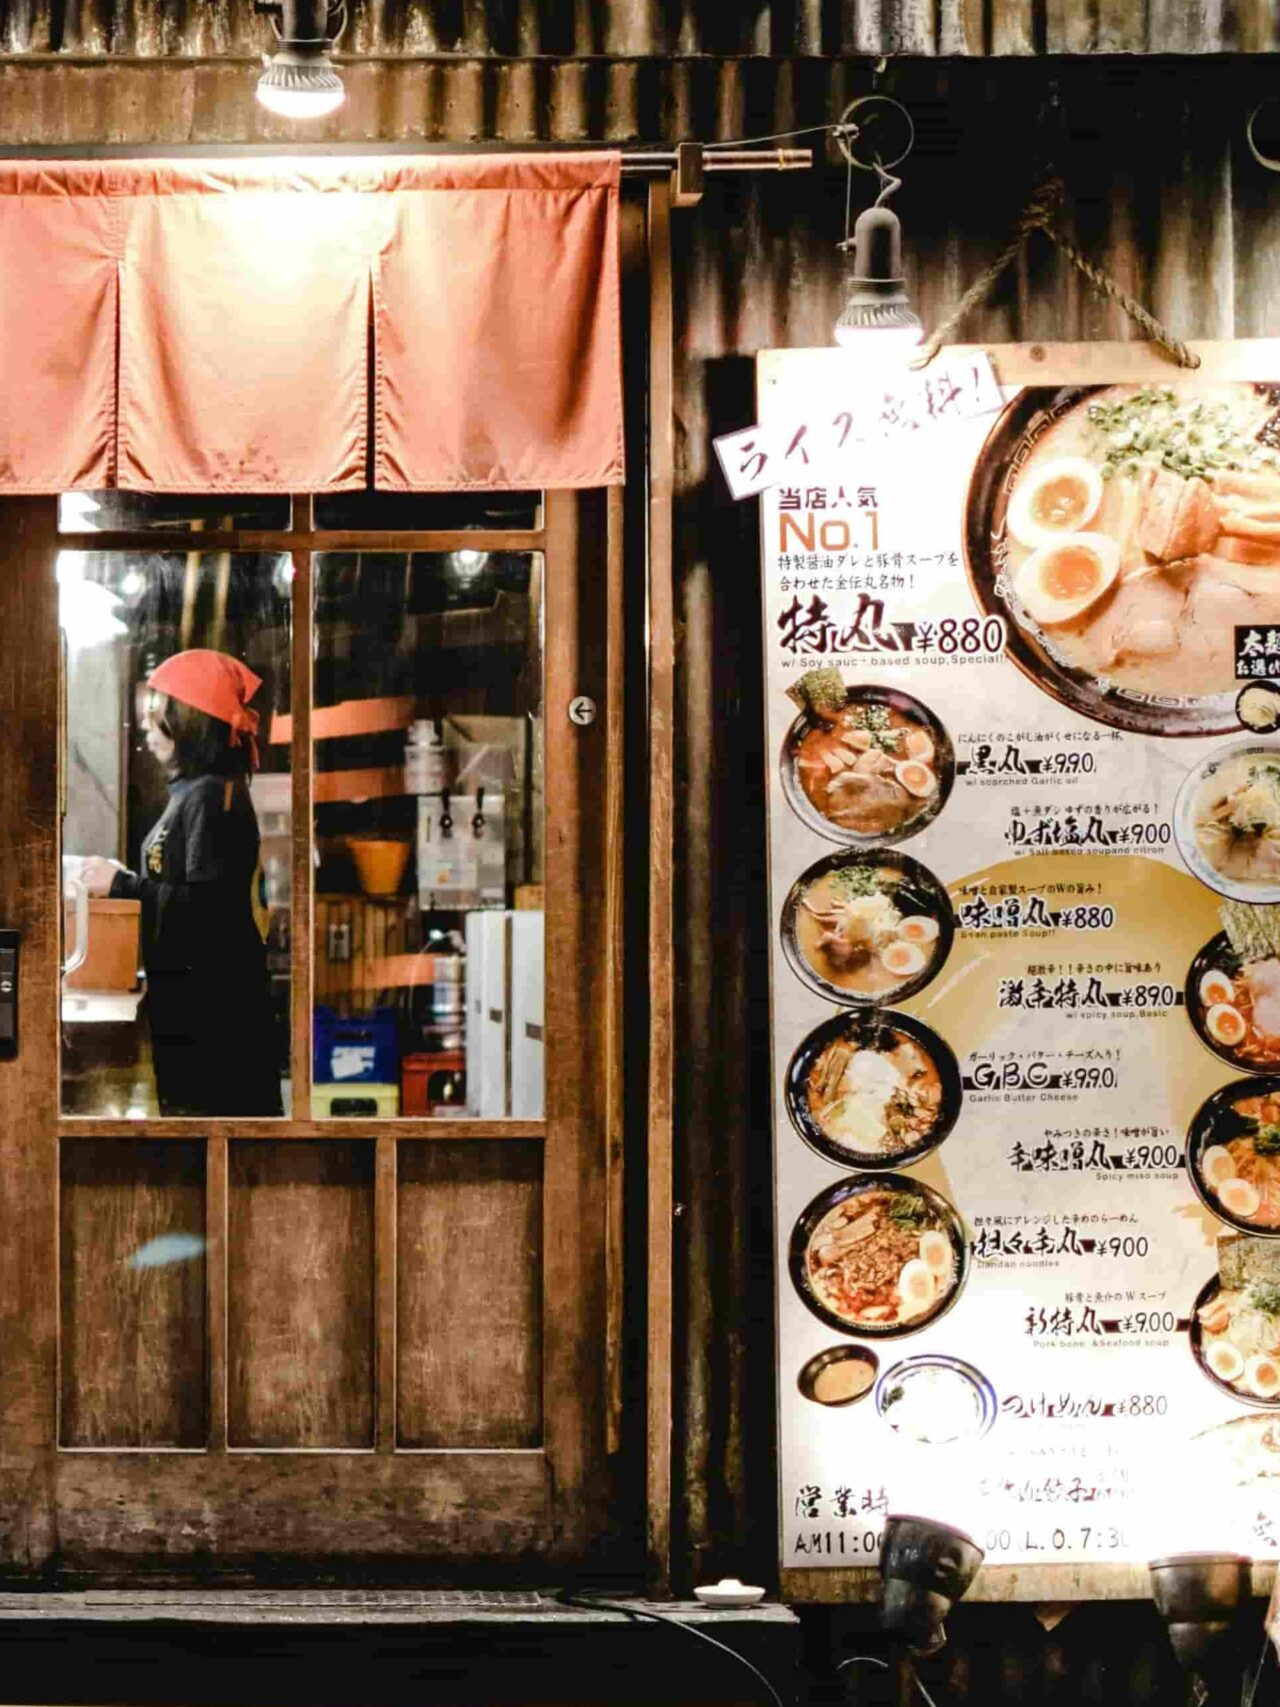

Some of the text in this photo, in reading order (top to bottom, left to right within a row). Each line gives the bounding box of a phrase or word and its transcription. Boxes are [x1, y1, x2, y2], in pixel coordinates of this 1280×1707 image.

[778, 486, 879, 510] 当店人気
[779, 511, 879, 553] No.1
[777, 552, 959, 571] 特製醤油ダレと豚骨スープを
[777, 593, 1004, 654] 特丸 ¥880
[800, 658, 823, 669] Soy
[871, 657, 910, 666] based
[969, 744, 1095, 775] 黒丸 ¥990
[980, 776, 1028, 786] scorched
[1031, 776, 1063, 785] Garlic
[1004, 816, 1171, 847] ゆず塩丸 ¥900
[960, 896, 1114, 929] 味噌丸 ¥880
[990, 930, 1019, 940] paste
[999, 977, 1174, 1009] 激辛特丸 ¥890
[1080, 1010, 1107, 1020] spicy
[1061, 1067, 1115, 1089] ¥990
[1004, 1093, 1036, 1102] Butter
[1040, 1092, 1079, 1102] Cheese
[1125, 1145, 1178, 1167] ¥900
[1096, 1171, 1179, 1182] Spicy miso soup
[1097, 1236, 1149, 1258] ¥900
[1122, 1311, 1175, 1333] ¥900
